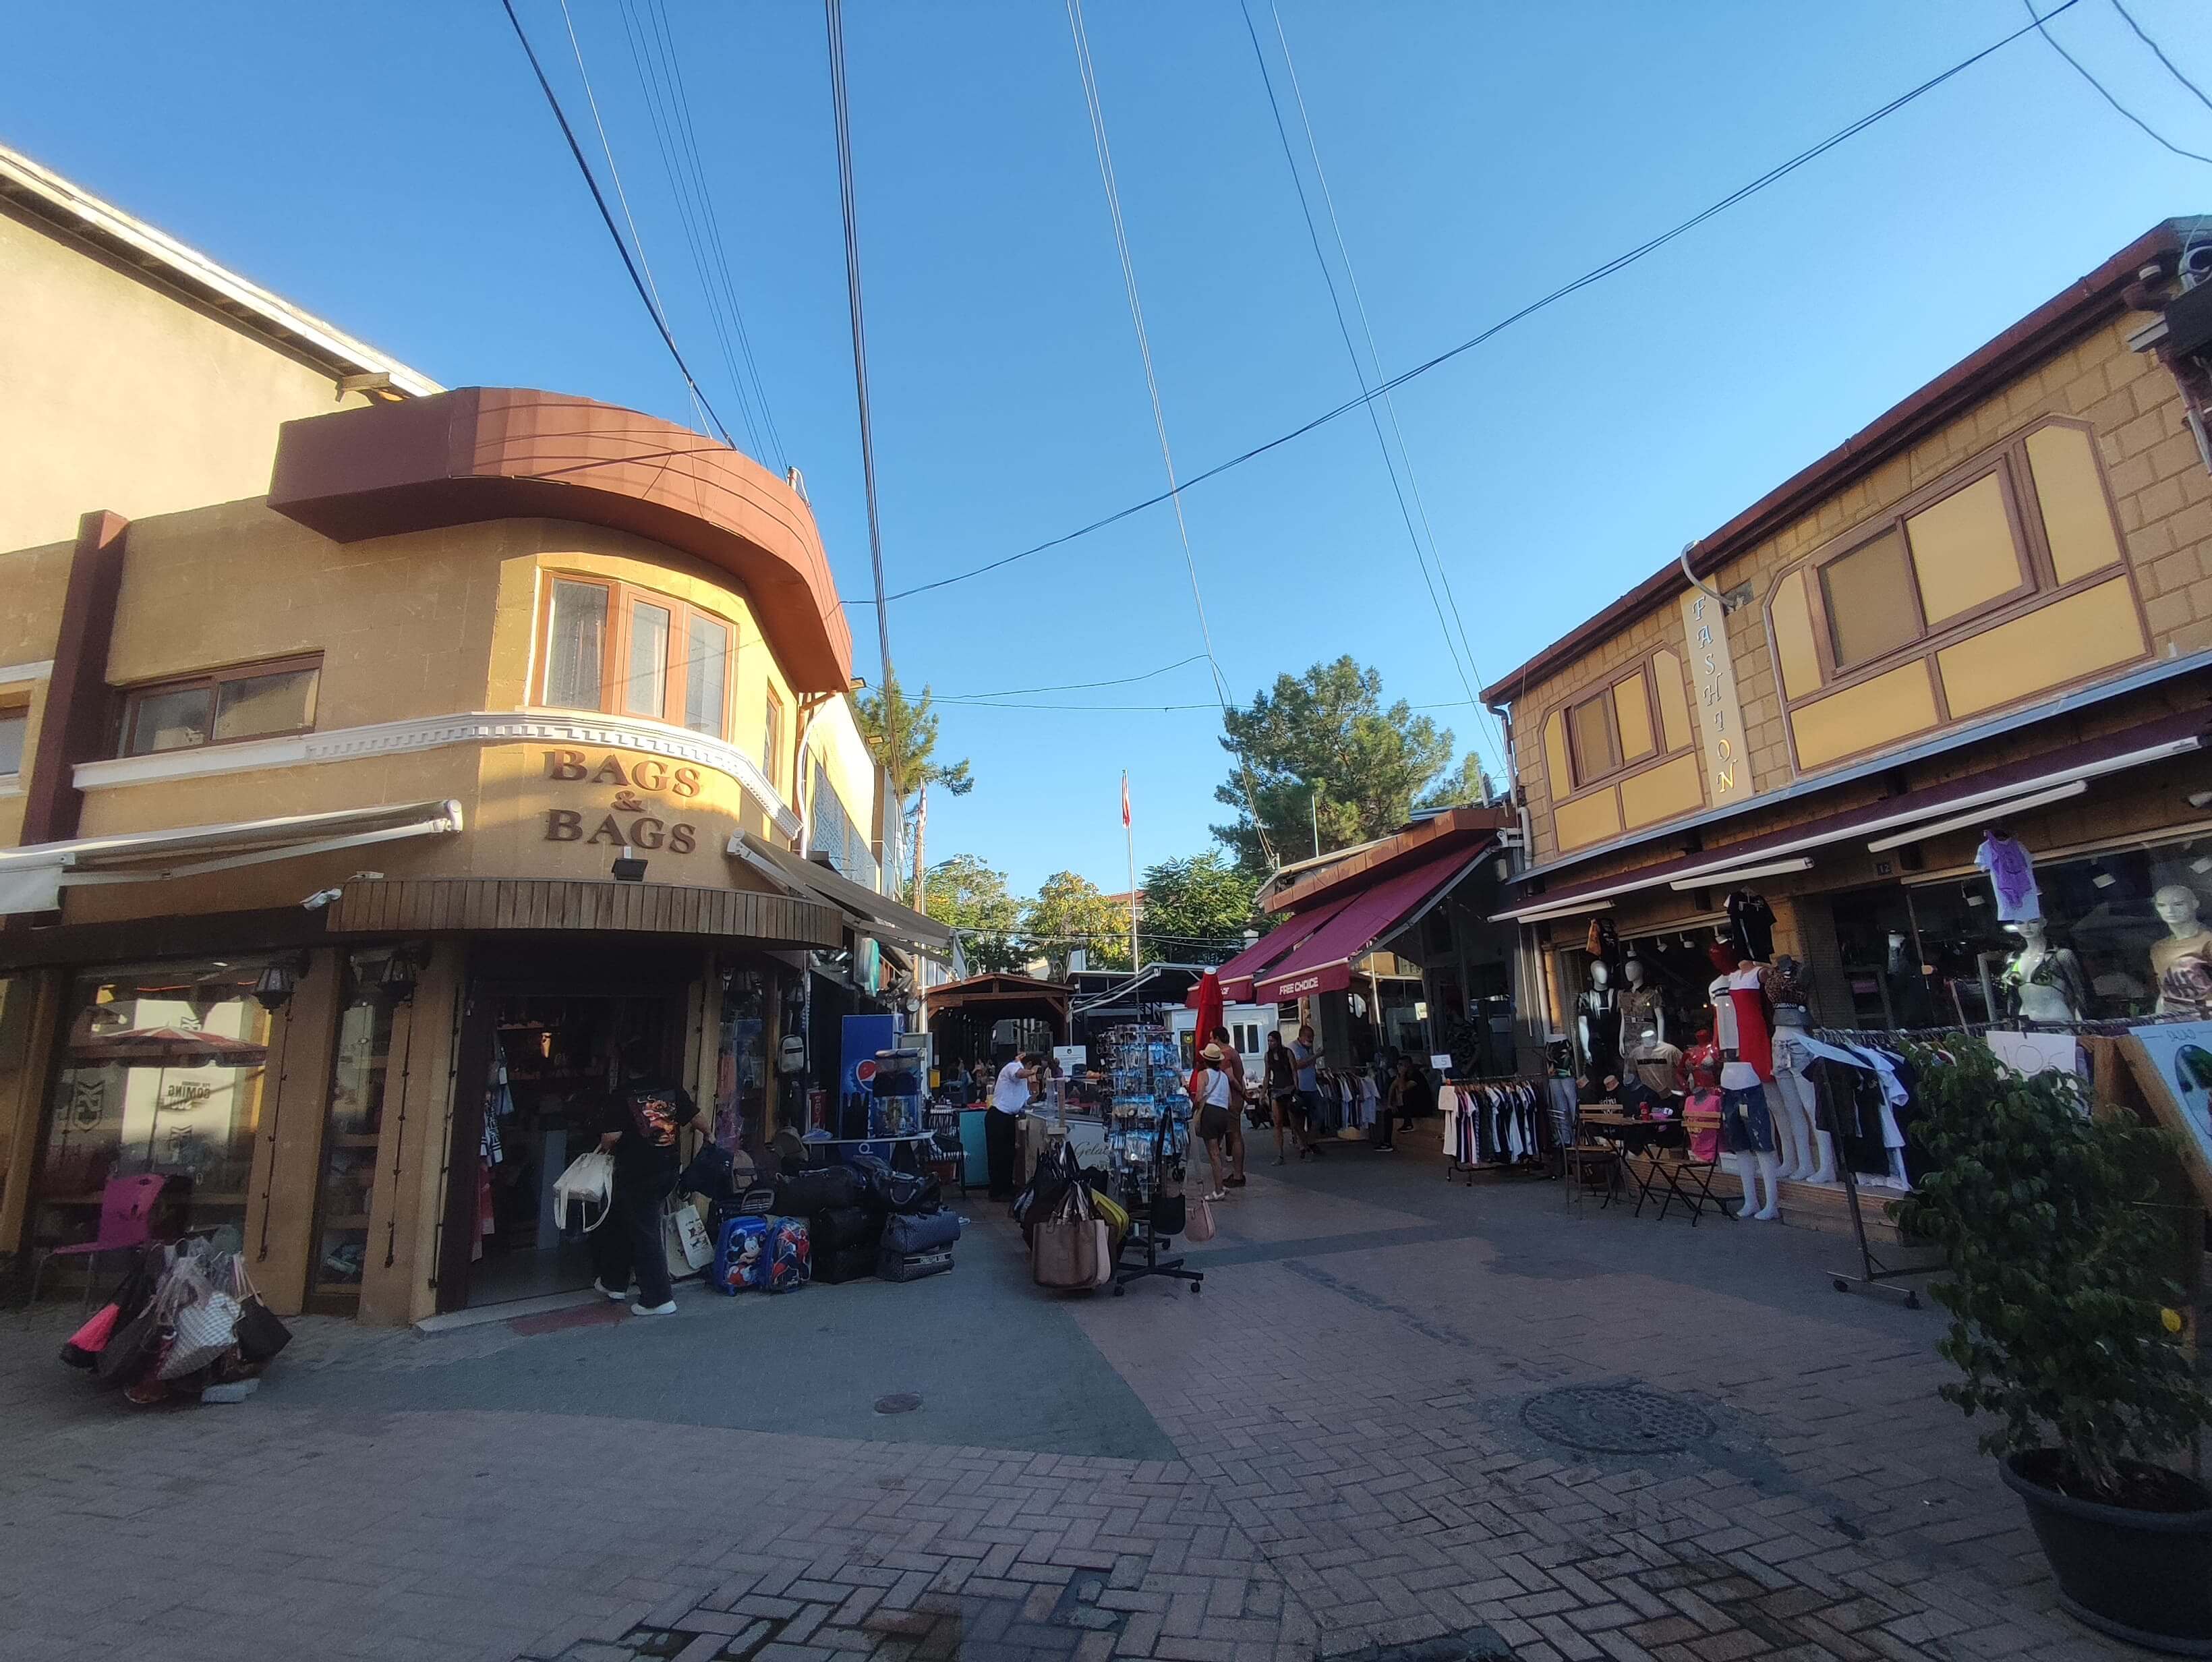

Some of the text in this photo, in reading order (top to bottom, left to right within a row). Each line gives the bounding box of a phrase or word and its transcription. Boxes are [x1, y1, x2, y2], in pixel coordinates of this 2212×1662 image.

[1691, 596, 1739, 793] FASHION
[548, 749, 701, 797] BAGS
[610, 790, 642, 812] &
[544, 809, 696, 854] BAGS
[1279, 977, 1318, 995] FREE CHOICE
